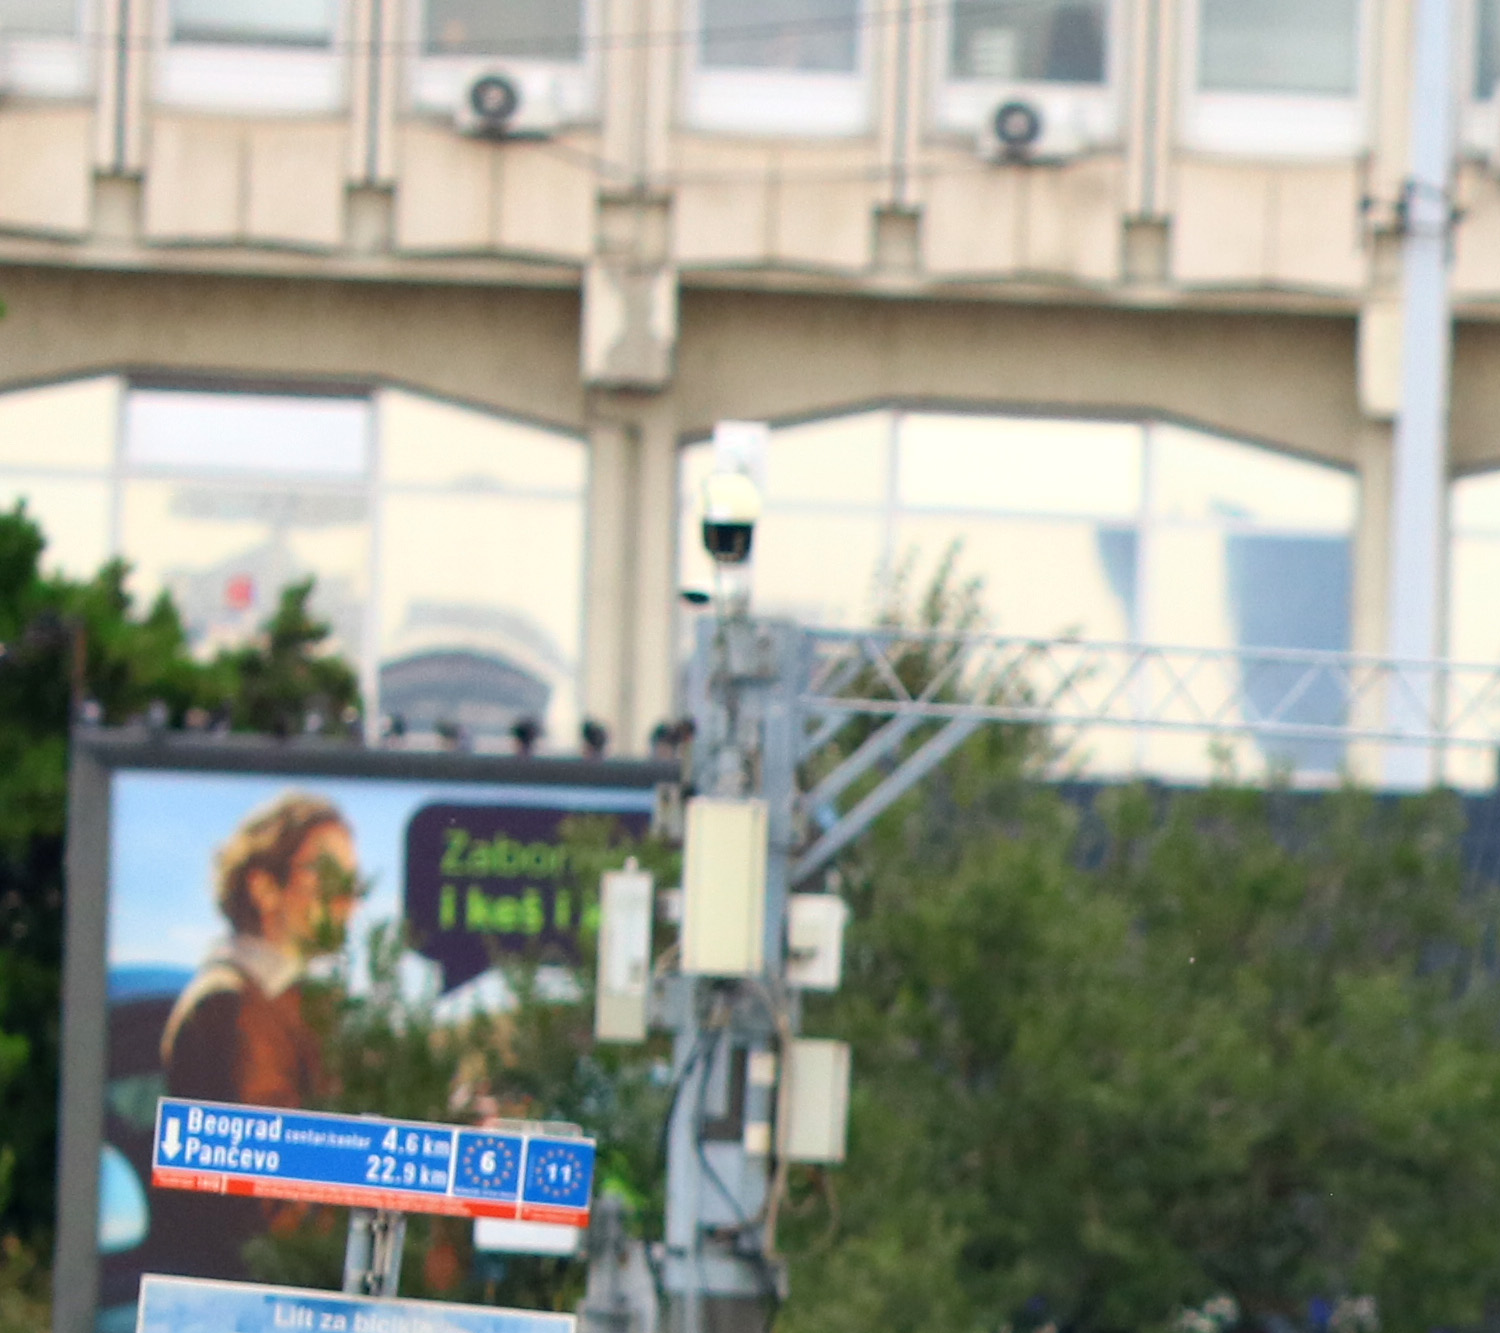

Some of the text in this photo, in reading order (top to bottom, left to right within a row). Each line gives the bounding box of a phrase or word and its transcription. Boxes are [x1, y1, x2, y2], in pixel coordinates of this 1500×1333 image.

[188, 1107, 283, 1146] Beograd
[382, 1127, 419, 1155] 4.6
[423, 1135, 450, 1156] km
[185, 1137, 447, 1185] Pančevo 22.9 km
[480, 1150, 497, 1174] 6
[547, 1162, 573, 1184] 11
[274, 1303, 313, 1328] Lift
[320, 1312, 347, 1332] za
